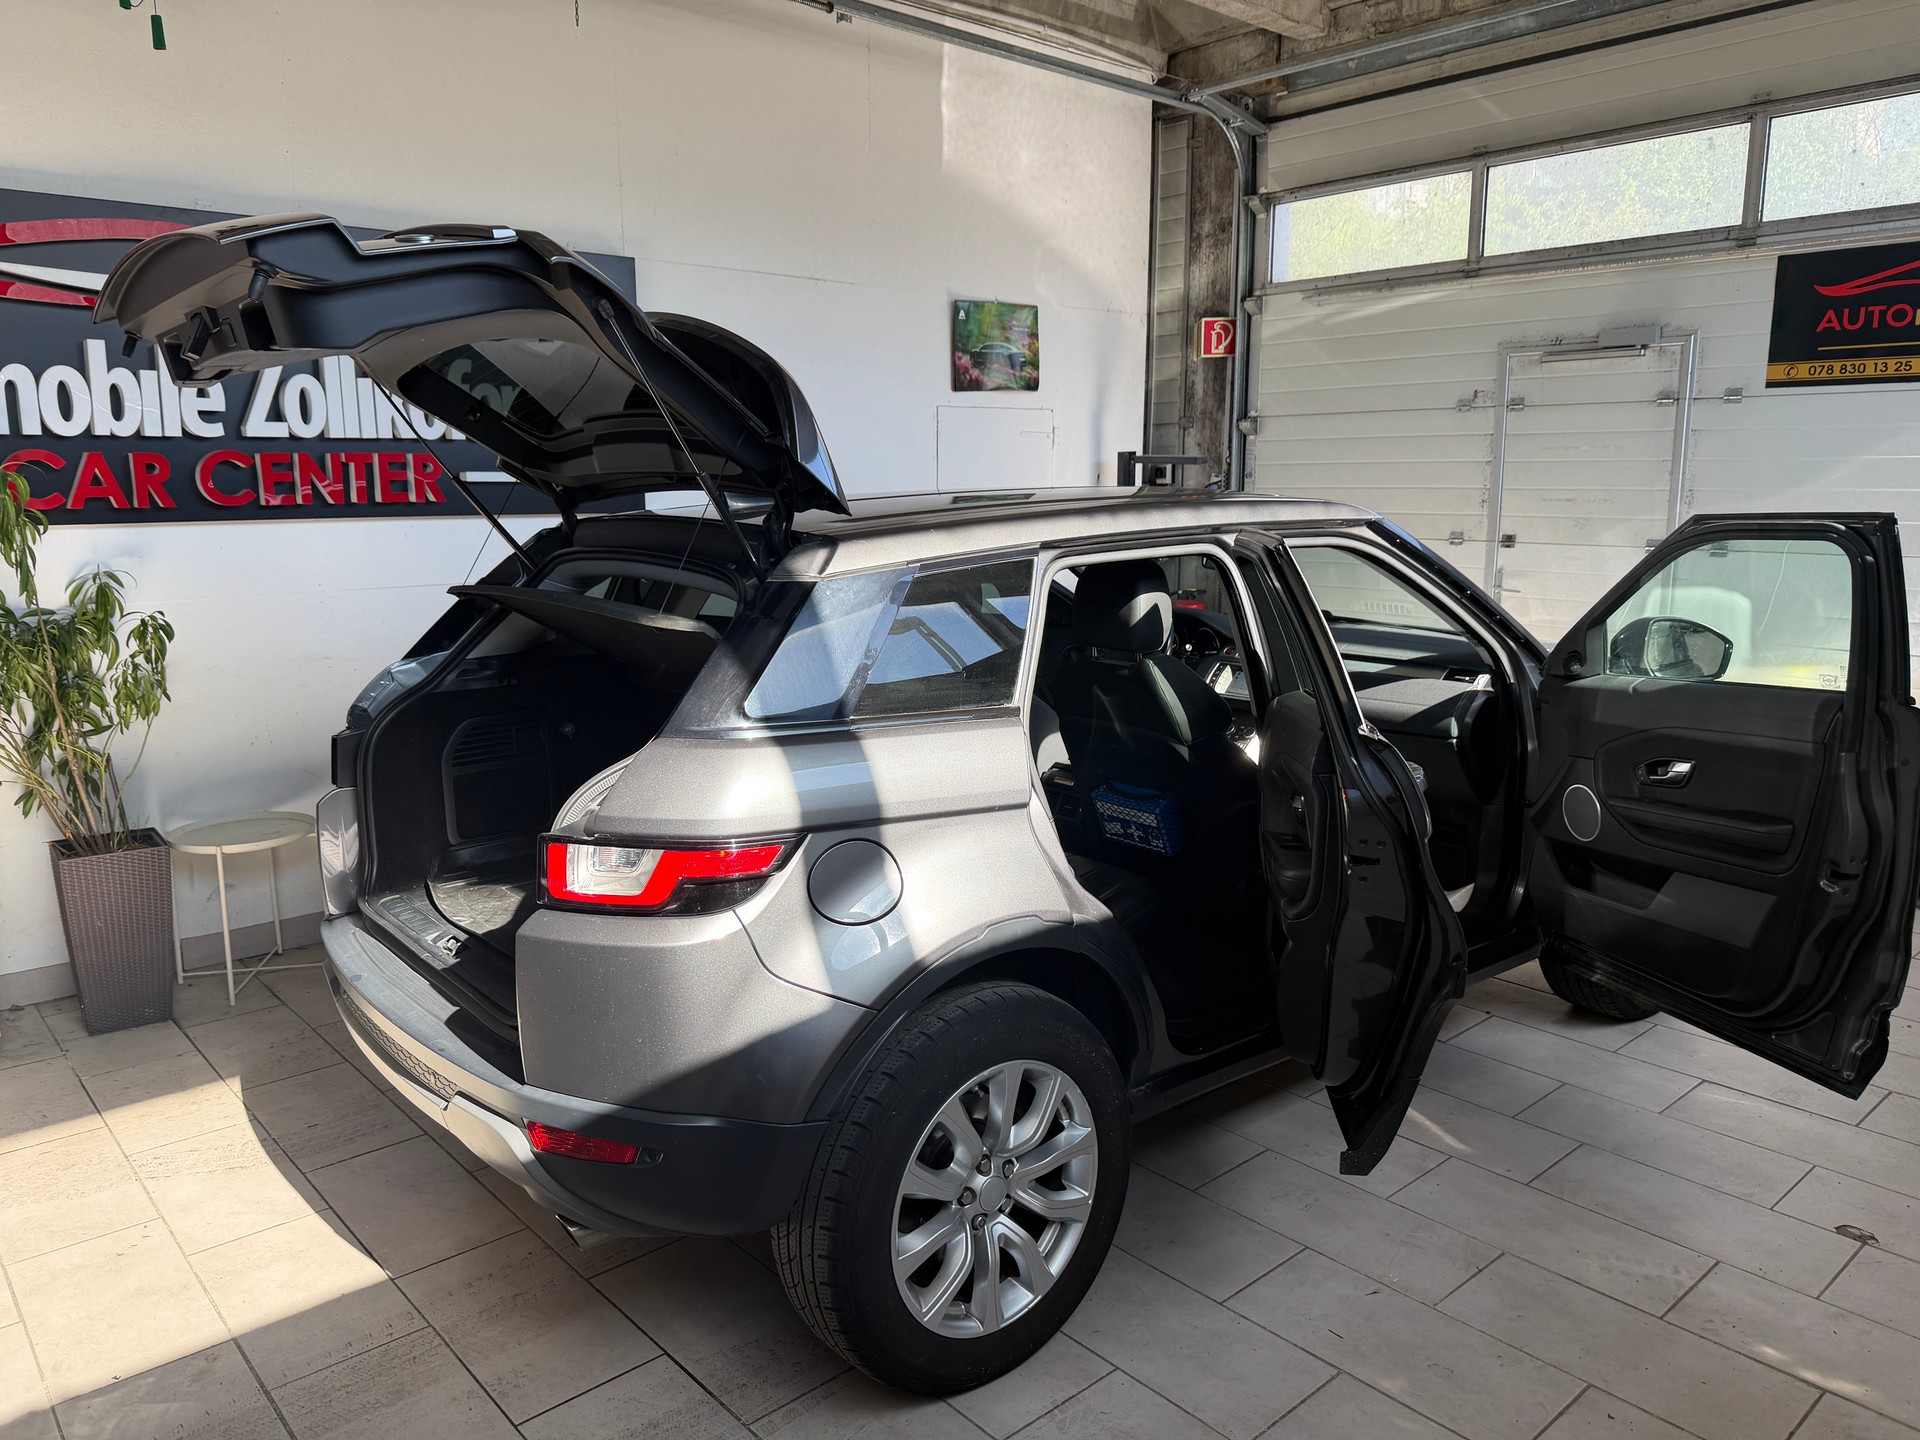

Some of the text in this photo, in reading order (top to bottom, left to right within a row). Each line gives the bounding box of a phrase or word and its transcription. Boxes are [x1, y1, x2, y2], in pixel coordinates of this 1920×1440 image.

[1816, 303, 1920, 333] AUTO
[1808, 360, 1912, 376] 078 830 13 25
[0, 449, 446, 511] CAR CENTER
